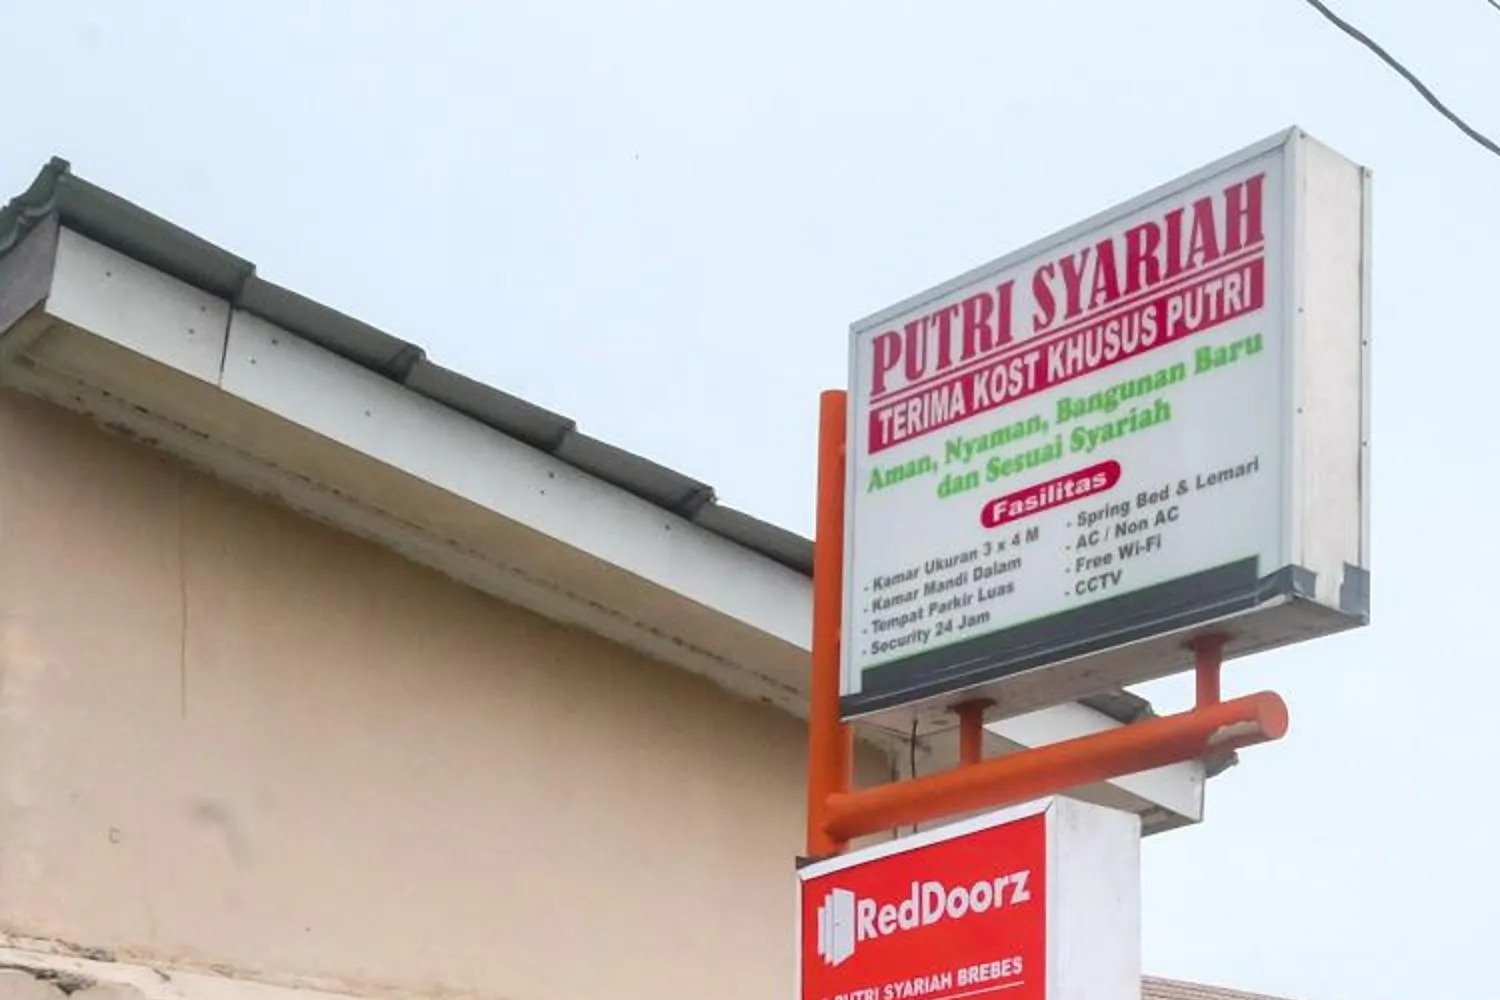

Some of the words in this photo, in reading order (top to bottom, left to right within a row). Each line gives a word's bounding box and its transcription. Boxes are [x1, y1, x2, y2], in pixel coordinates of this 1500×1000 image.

[869, 280, 1015, 397] PUTRI
[1032, 172, 1267, 331] SYARIAH
[879, 384, 966, 444] TERIMA
[973, 353, 1040, 410] KOST
[1047, 304, 1157, 382] KHUSUS
[1166, 267, 1251, 337] PUTRI
[867, 453, 938, 494] Aman,
[944, 414, 1049, 464] Nyaman,
[1055, 361, 1186, 424] Bangunan
[1193, 333, 1263, 374] Baru
[937, 470, 980, 499] dan
[986, 440, 1063, 482] Sesuai
[1069, 398, 1172, 454] Syariah
[992, 470, 1107, 522] Fasilitas
[1077, 500, 1130, 527] Spring
[1136, 484, 1169, 509] Bed
[1175, 480, 1188, 496] &
[1196, 456, 1260, 489] Lemari
[1075, 552, 1112, 573] Free
[1118, 534, 1161, 560] Wi-Fi
[1076, 531, 1100, 550] AC
[1114, 521, 1148, 538] Non
[1154, 506, 1179, 526] AC
[872, 589, 919, 613] Kamar
[923, 572, 968, 597] Mandi
[973, 557, 1022, 582] Dalam
[873, 567, 920, 592] Kamar
[924, 549, 978, 575] Ukuran
[983, 541, 992, 556] 3
[998, 540, 1006, 551] x
[1011, 533, 1020, 546] 4
[1025, 526, 1039, 543] M
[1075, 570, 1122, 596] CCTV
[871, 628, 931, 655] Security
[935, 620, 953, 637] 24
[958, 611, 991, 630] Jam
[872, 608, 923, 633] Tempat
[928, 593, 973, 617] Parkir
[978, 582, 1015, 602] Luas
[857, 870, 1031, 941] RedDoorz
[883, 971, 952, 1000] SYARIAH
[957, 956, 1023, 986] BREBES
